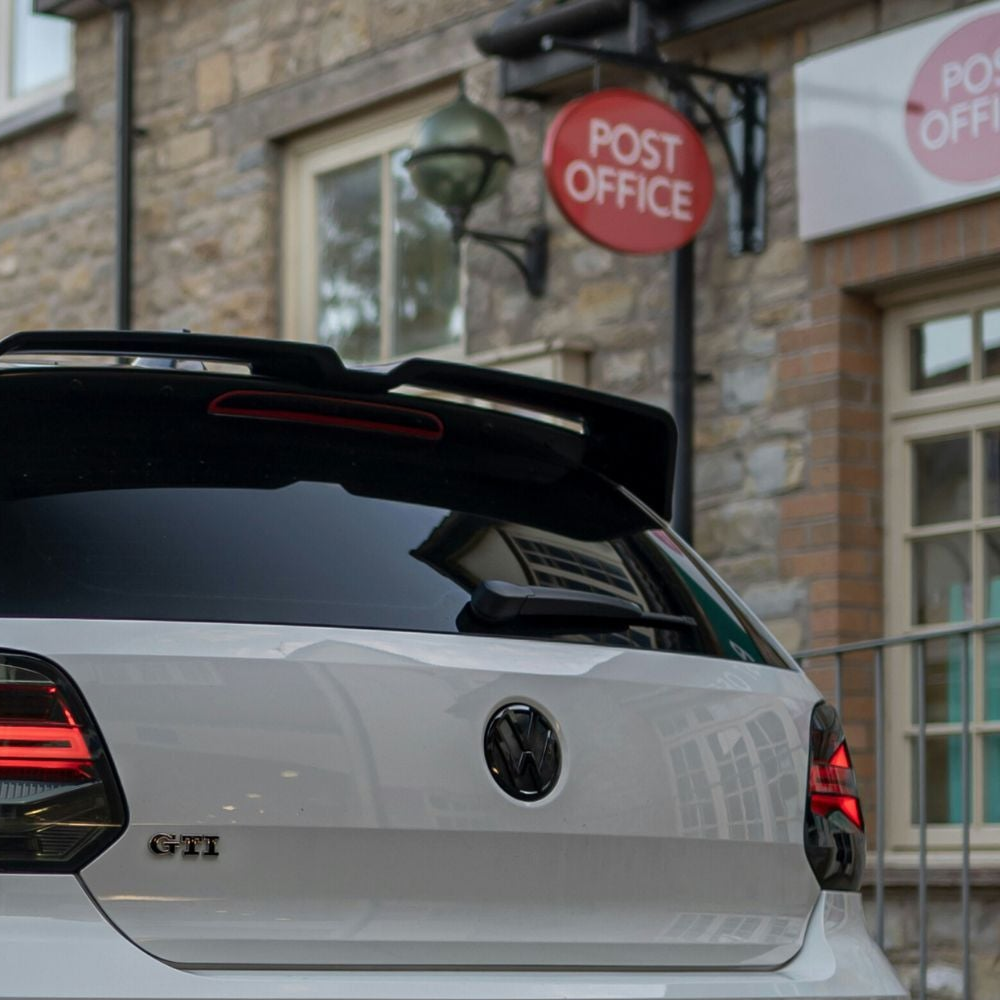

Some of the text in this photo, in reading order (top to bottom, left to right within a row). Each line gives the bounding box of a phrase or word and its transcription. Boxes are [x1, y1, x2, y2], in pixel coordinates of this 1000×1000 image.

[589, 118, 683, 173] POST
[565, 160, 693, 222] OFFICE
[148, 833, 220, 856] GTI
